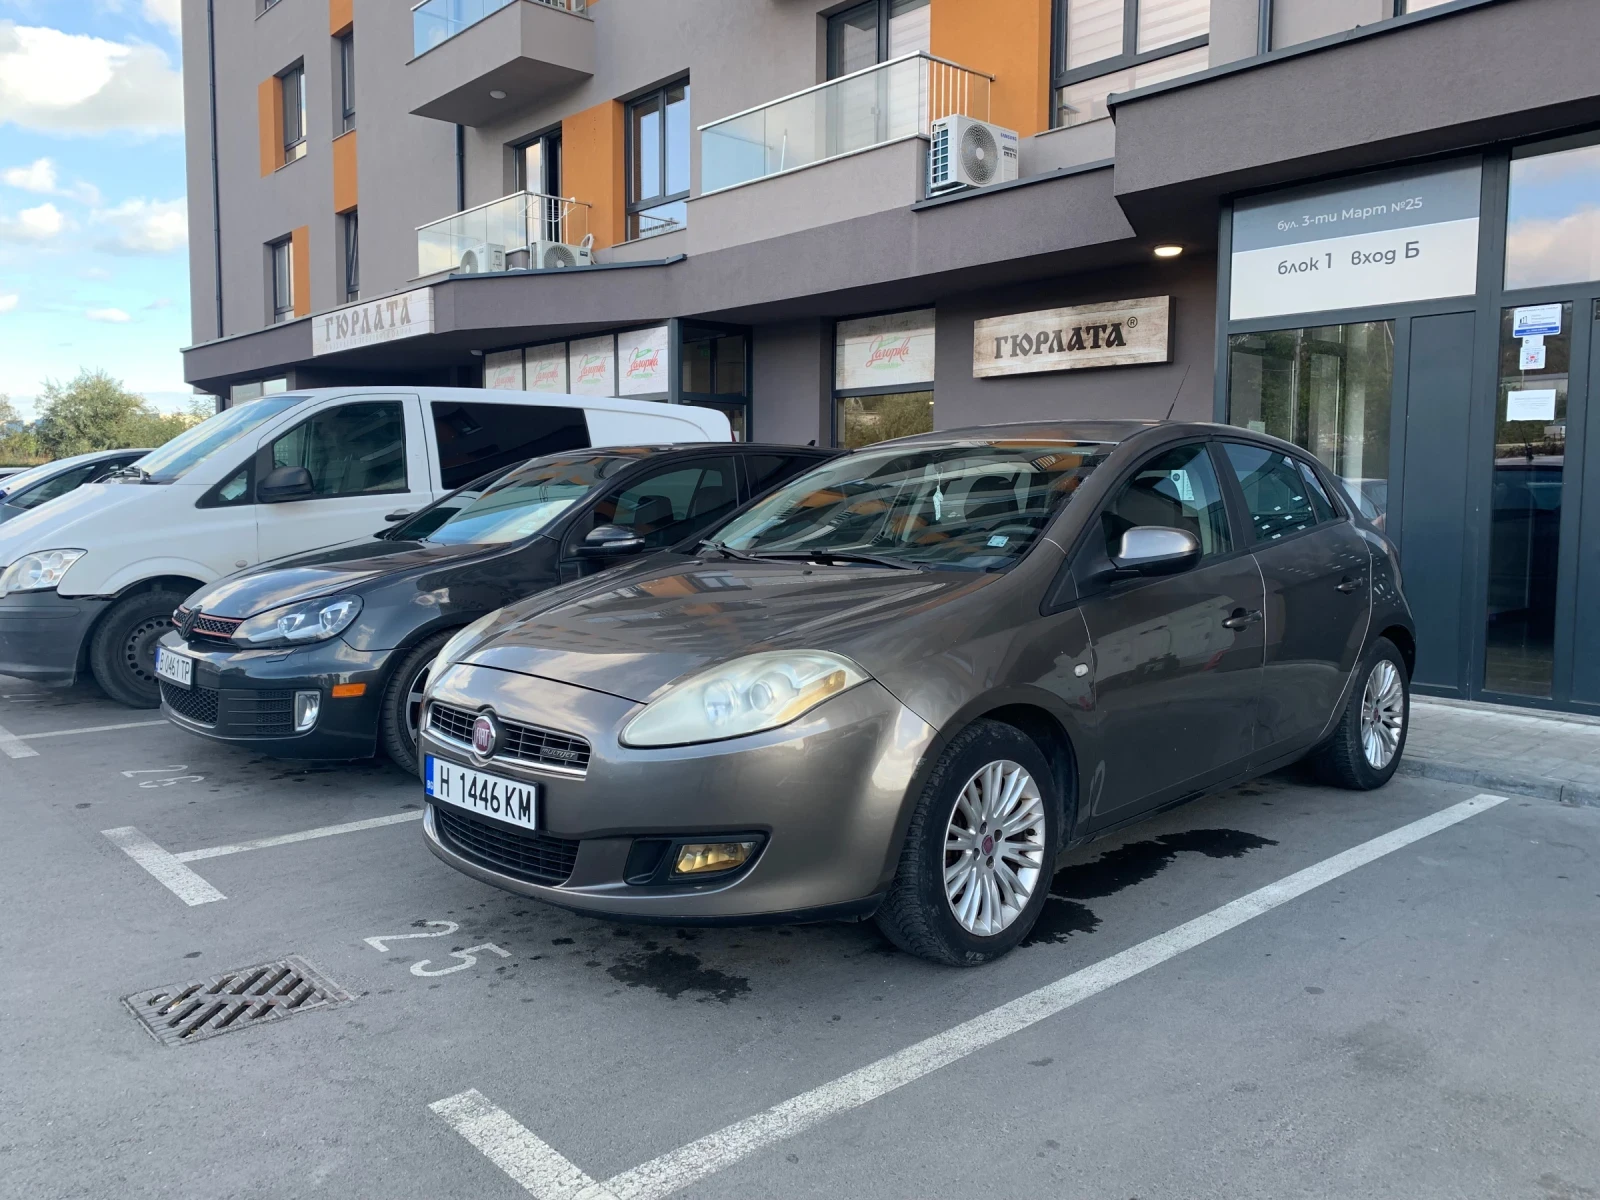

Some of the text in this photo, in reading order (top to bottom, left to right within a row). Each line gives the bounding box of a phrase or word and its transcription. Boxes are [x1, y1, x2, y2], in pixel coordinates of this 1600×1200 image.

[1277, 196, 1423, 232] бул. 3-ти Март №25
[1277, 240, 1420, 275] блок 1 вход Б
[325, 297, 411, 342] ГЮРЛАТА
[994, 322, 1127, 359] ГЮРЛАТА
[476, 726, 490, 747] FIAT
[120, 764, 205, 788] 23
[440, 765, 450, 798] H
[362, 920, 513, 977] 25
